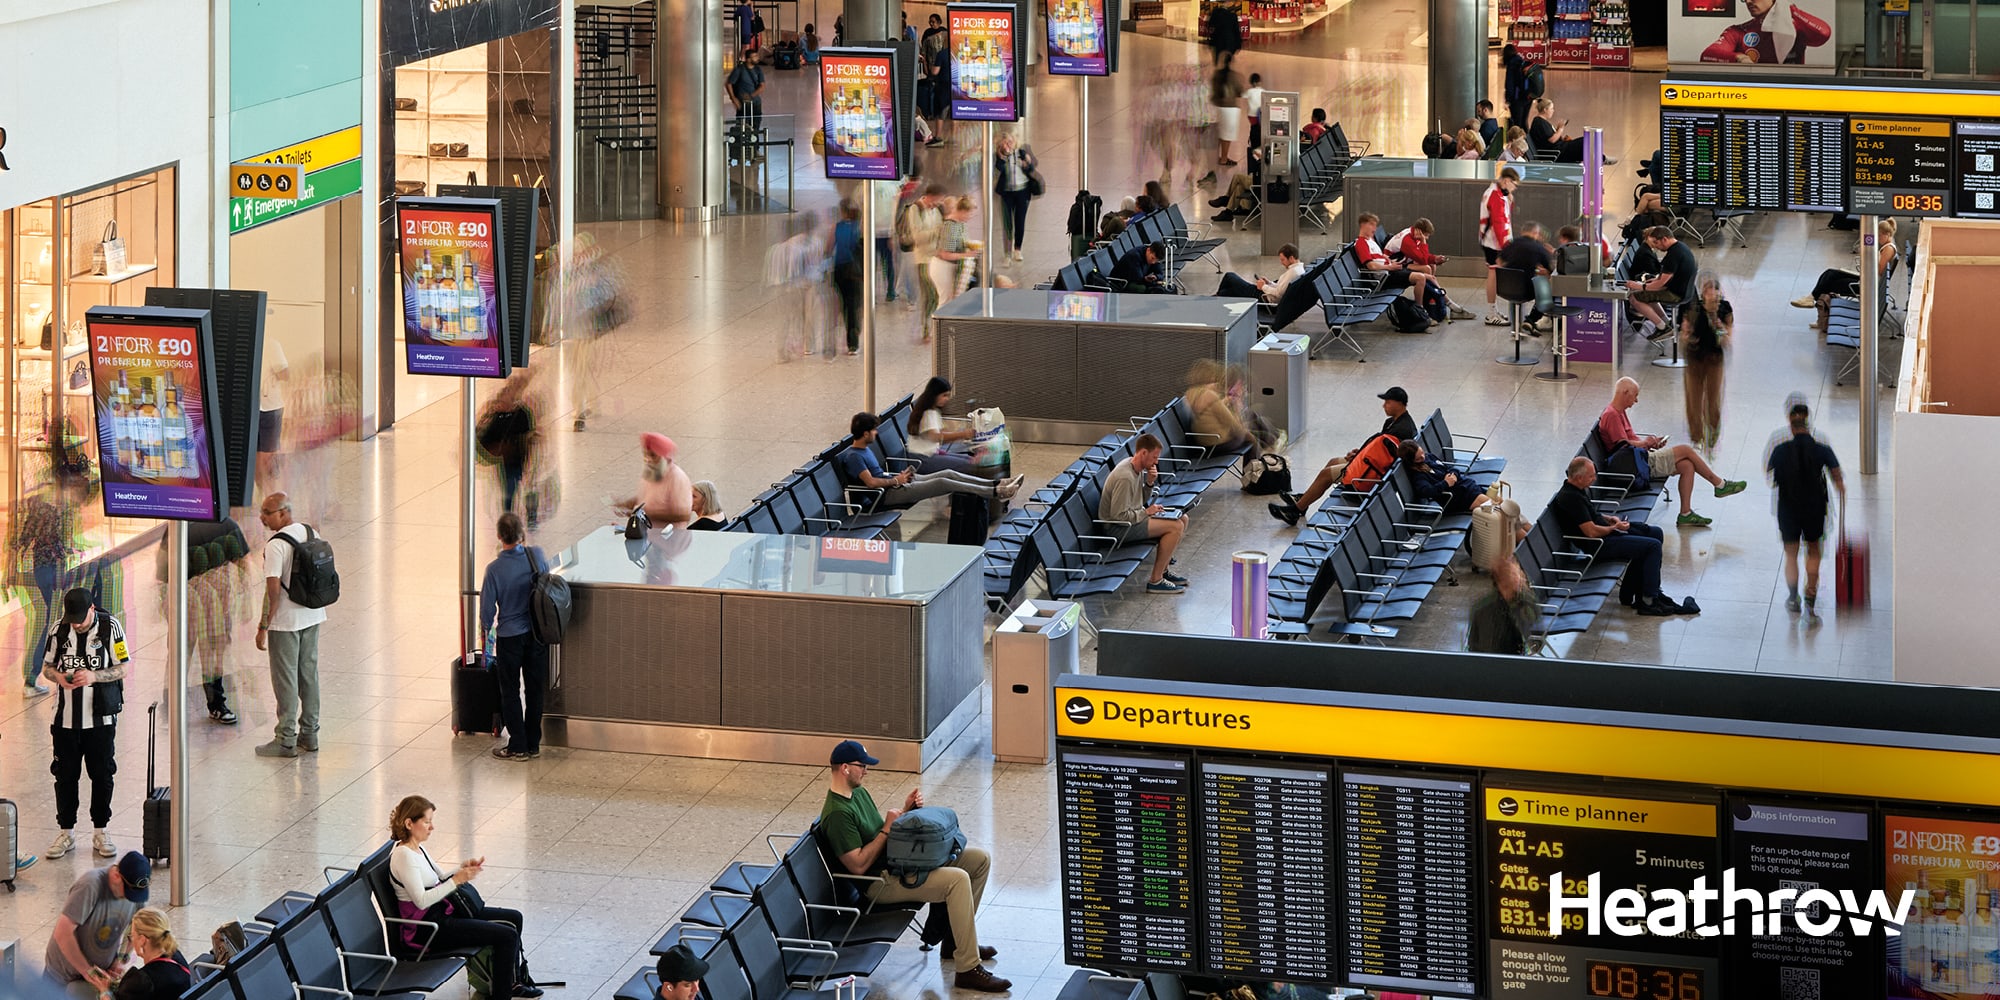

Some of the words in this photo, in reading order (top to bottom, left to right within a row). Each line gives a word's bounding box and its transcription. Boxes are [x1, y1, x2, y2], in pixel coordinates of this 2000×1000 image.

[953, 18, 959, 27] 2
[988, 18, 1008, 28] £90
[826, 64, 832, 74] 2
[864, 65, 886, 76] £90
[1681, 89, 1748, 100] Departures
[1890, 124, 1921, 133] planner
[1856, 157, 1895, 166] A16-A26
[1894, 195, 1942, 211] 08:36
[406, 220, 415, 234] 2
[458, 222, 487, 237] £90
[97, 335, 108, 353] 2
[158, 338, 192, 356] £90
[115, 492, 147, 501] Heathrow
[1103, 700, 1251, 731] Departures
[1524, 800, 1570, 817] Time
[1575, 803, 1649, 824] planner
[1751, 810, 1777, 821] Maps
[1779, 812, 1836, 825] information
[1499, 827, 1526, 838] Gates
[1499, 838, 1564, 858] A1-A5
[1751, 845, 1764, 853] For
[1777, 847, 1820, 858] up-to-date
[1822, 851, 1840, 860] map
[1841, 851, 1850, 860] of
[1635, 849, 1647, 866] 5
[1650, 855, 1705, 870] minutes
[1767, 856, 1802, 866] terminal,
[1804, 859, 1830, 869] please
[1500, 863, 1529, 874] Gates
[1781, 866, 1802, 875] code:
[1500, 874, 1588, 896] A16-26
[1501, 898, 1530, 909] Gates
[1500, 909, 1584, 931] B31-49
[1501, 926, 1515, 936] via
[1752, 942, 1793, 952] directions.
[1776, 936, 1825, 946] step-by-step
[1502, 949, 1535, 961] Please
[1536, 951, 1566, 963] allow
[1752, 951, 1780, 960] choose
[1801, 956, 1844, 966] download:
[1502, 961, 1541, 972] enough
[1544, 962, 1567, 973] time
[1502, 969, 1513, 980] to
[1516, 970, 1544, 982] reach
[1547, 974, 1570, 984] your
[1591, 964, 1700, 1000] 08:36
[1503, 979, 1526, 990] gate
